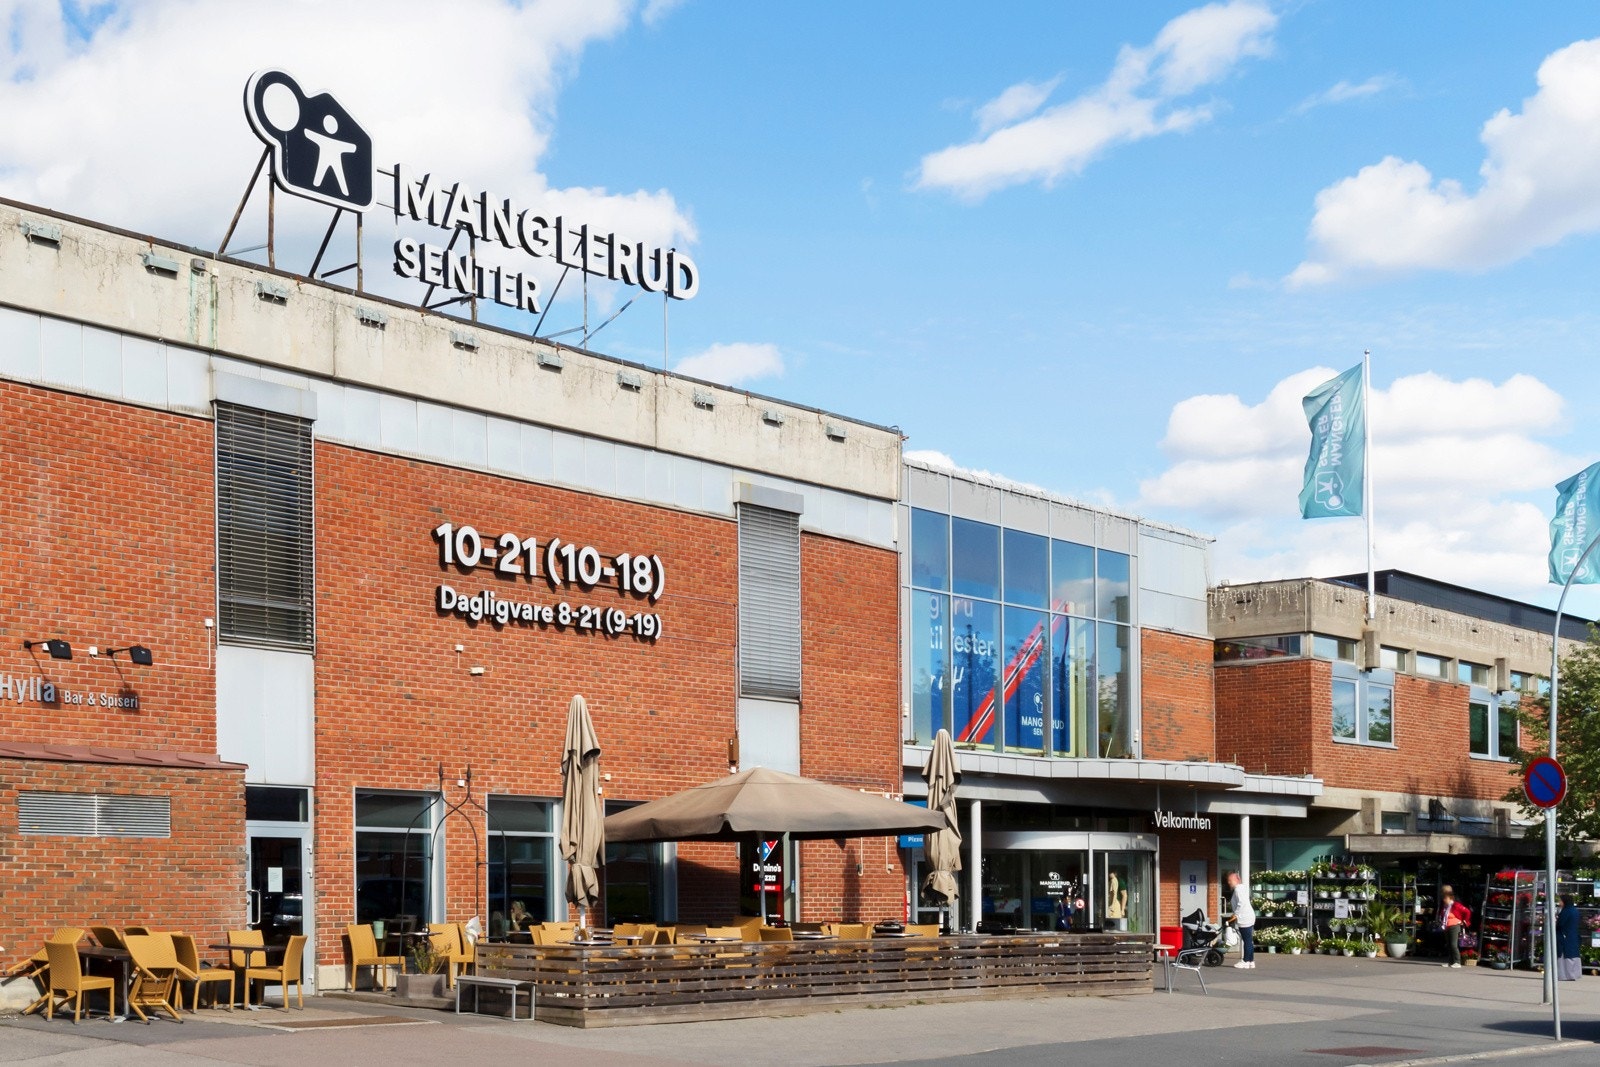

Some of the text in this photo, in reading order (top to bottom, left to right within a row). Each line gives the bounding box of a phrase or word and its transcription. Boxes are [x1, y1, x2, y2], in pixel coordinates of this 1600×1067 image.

[394, 162, 699, 301] MANGLERUD
[393, 236, 542, 314] SENTER
[434, 522, 665, 600] 10-21 (10-18)
[438, 585, 662, 640] Dagligvare 8-21 (9-19)
[952, 628, 994, 656] ester
[0, 673, 138, 709] Hylla Bar & Spiseri
[1021, 716, 1064, 730] MANGRUD
[1154, 811, 1211, 830] Velkommen
[753, 863, 782, 873] Dmino's
